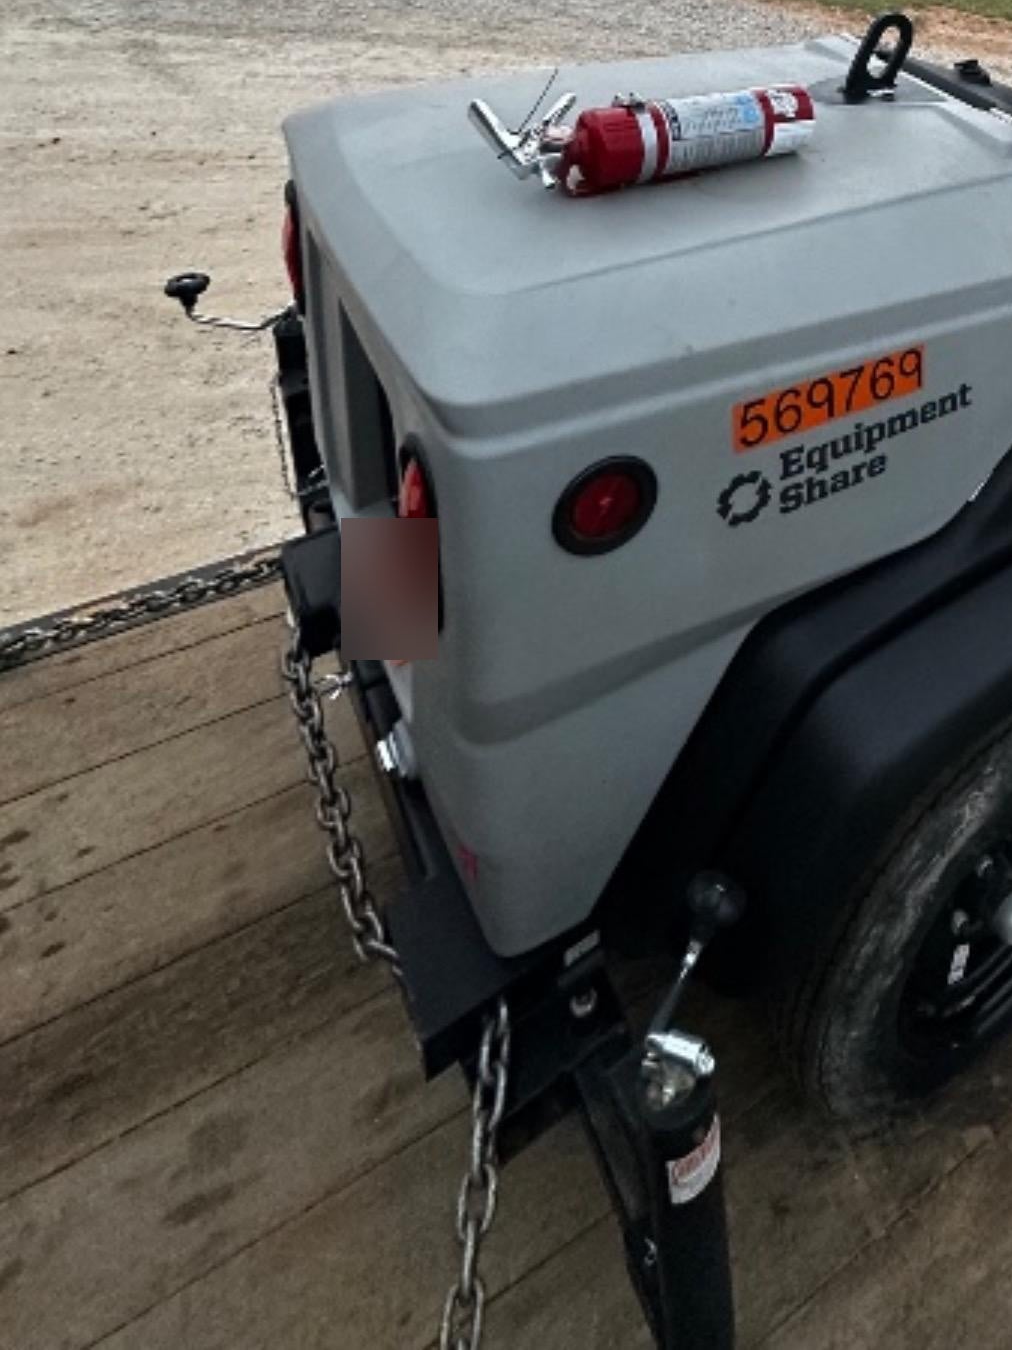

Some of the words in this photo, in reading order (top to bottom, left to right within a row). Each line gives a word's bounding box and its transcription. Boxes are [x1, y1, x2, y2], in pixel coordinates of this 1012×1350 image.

[739, 347, 925, 448] 569769
[778, 382, 973, 481] Equipment
[779, 453, 888, 514] Share
